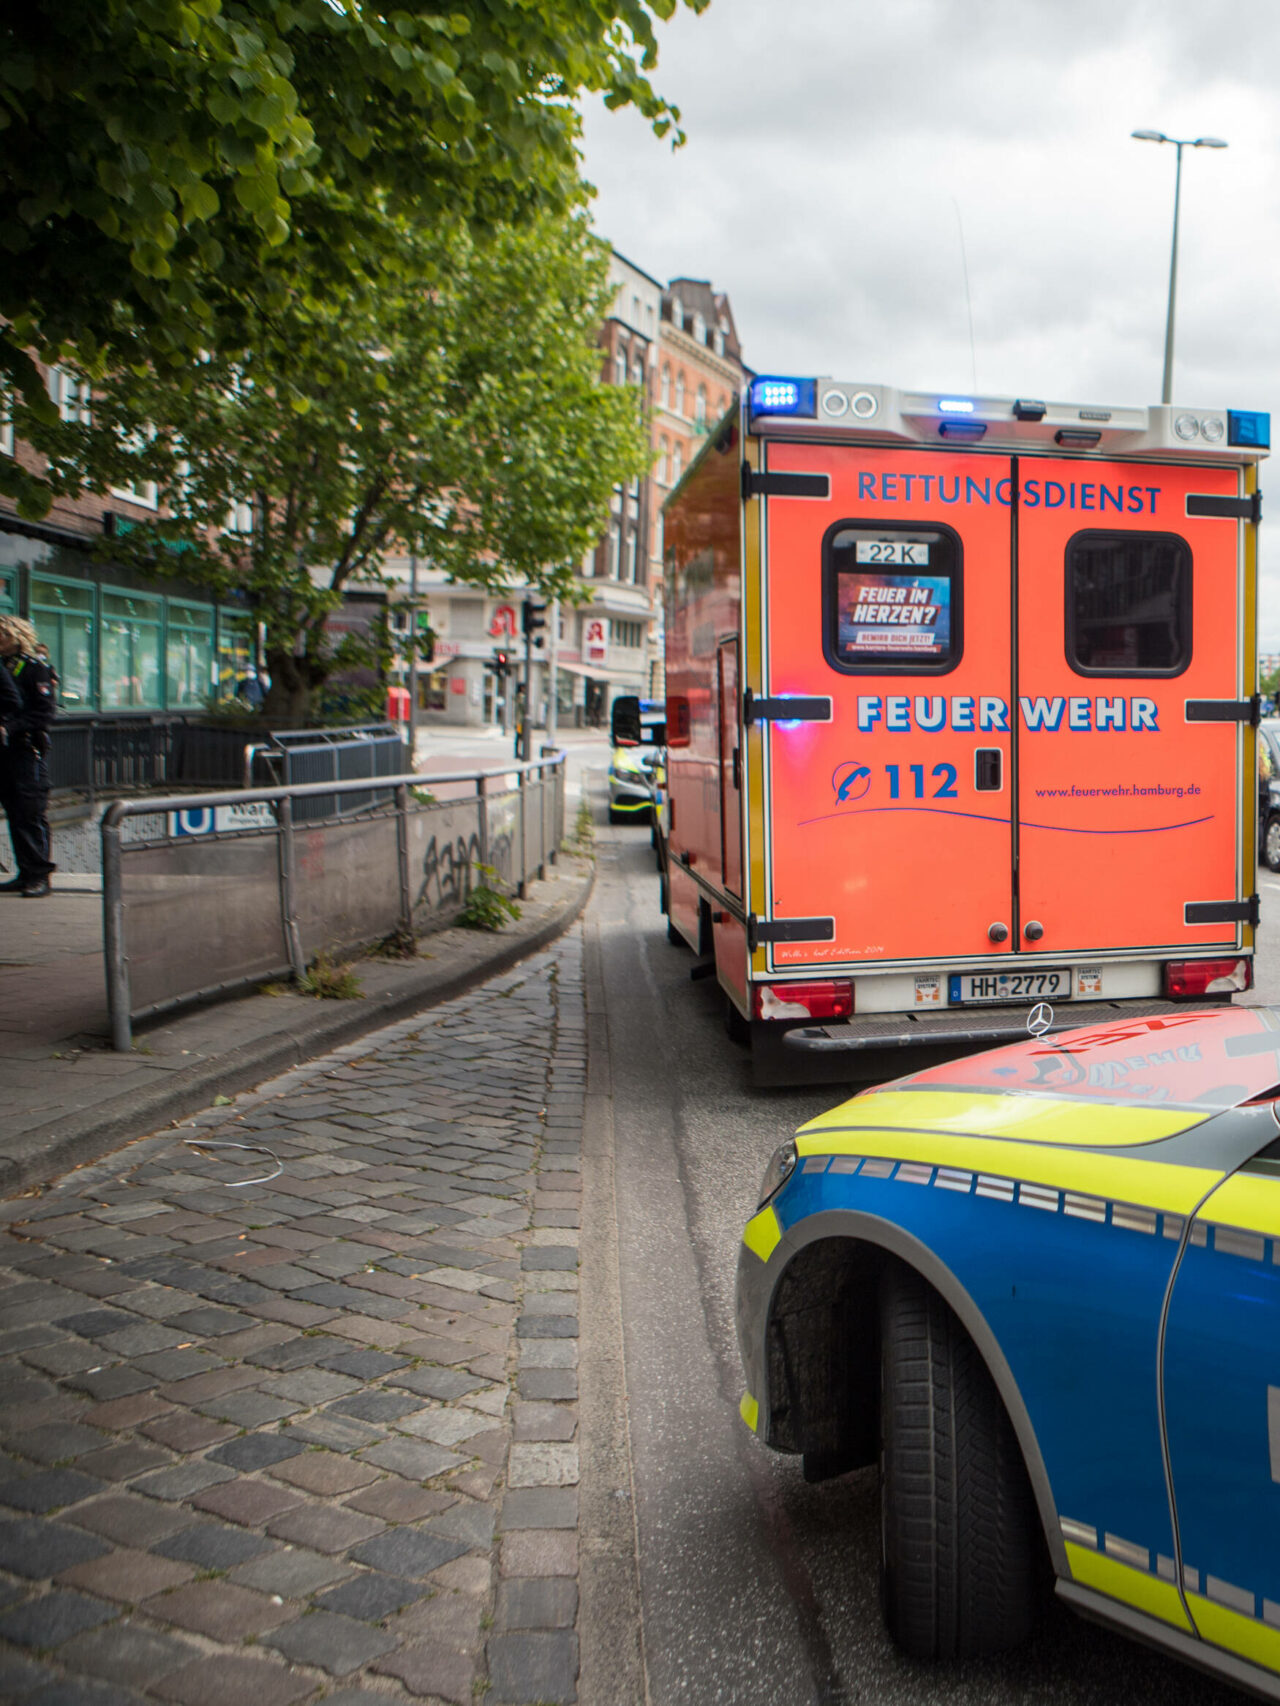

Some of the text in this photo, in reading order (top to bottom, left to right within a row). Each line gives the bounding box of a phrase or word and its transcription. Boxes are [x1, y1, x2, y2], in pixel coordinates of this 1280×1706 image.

[858, 471, 1161, 514] RETTUNGSDIENST
[869, 544, 916, 564] 22 K
[858, 587, 929, 604] FEUER IM
[853, 604, 936, 625] HERZEN?
[885, 762, 958, 799] 112
[1035, 784, 1201, 798] www.feuerwehr.hamburg.de
[970, 974, 1060, 997] HH 2779
